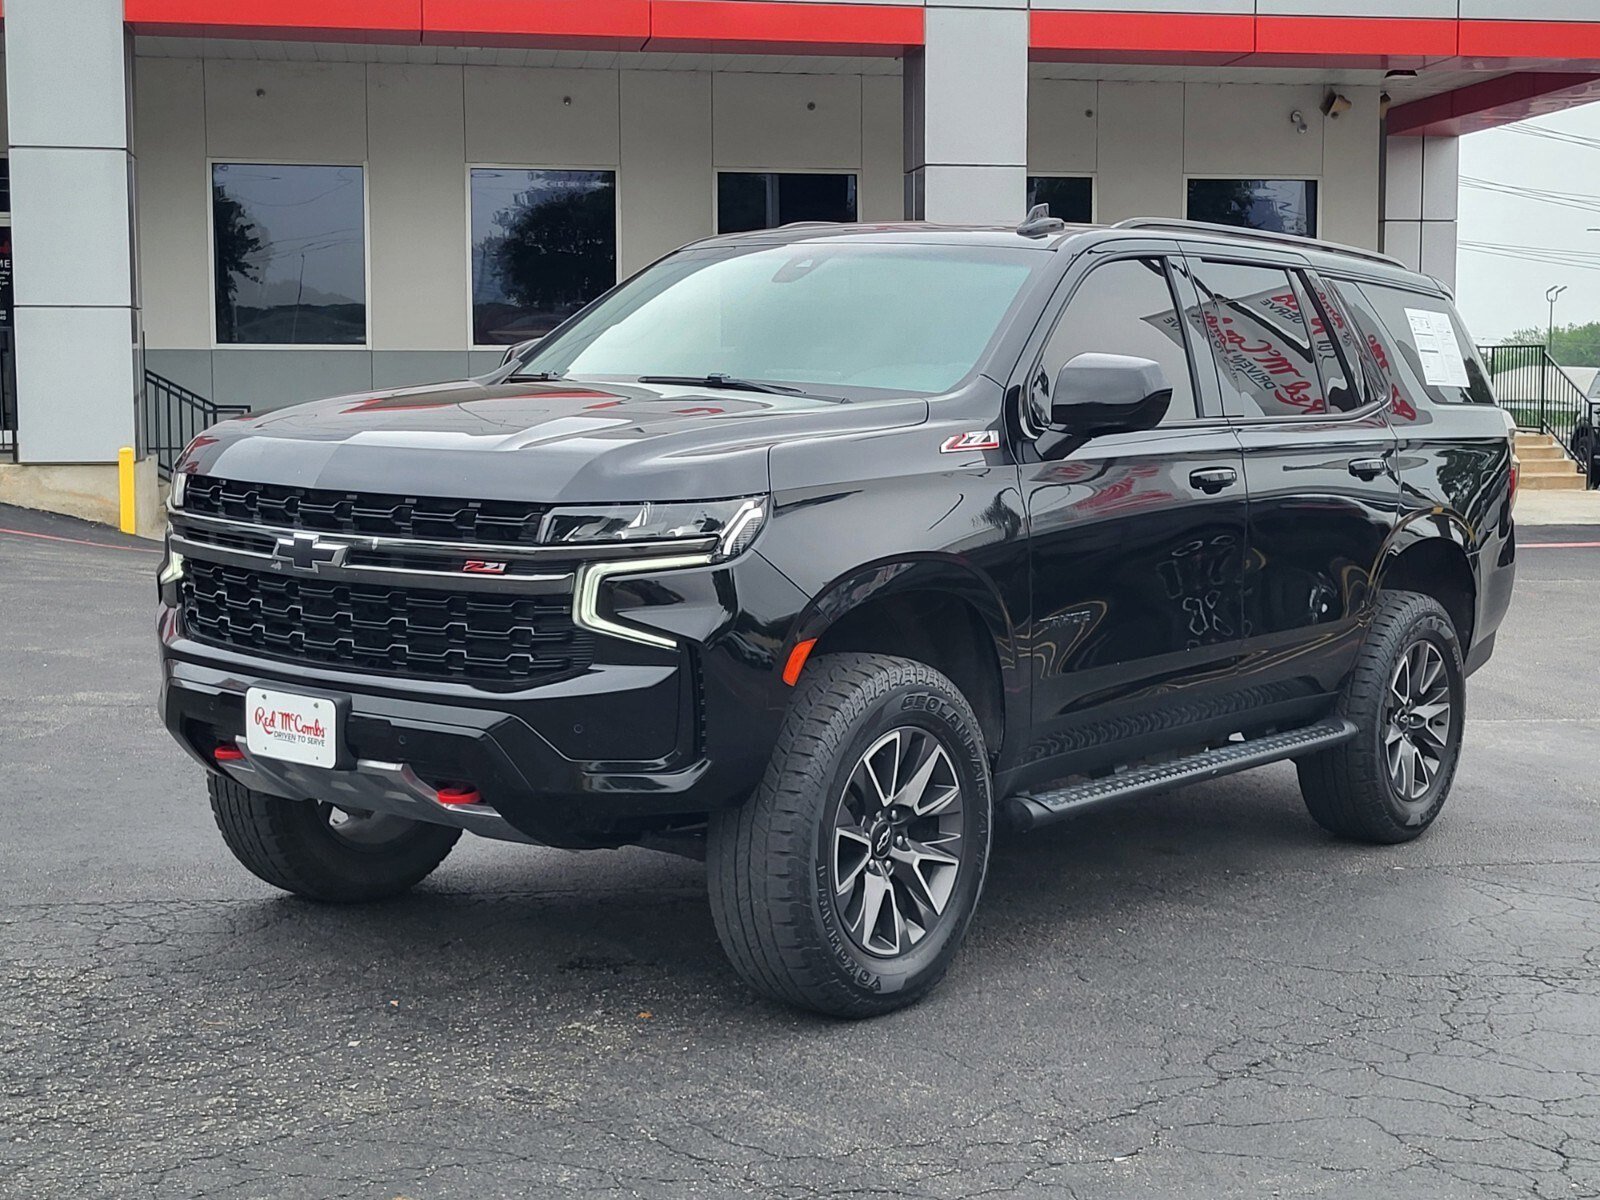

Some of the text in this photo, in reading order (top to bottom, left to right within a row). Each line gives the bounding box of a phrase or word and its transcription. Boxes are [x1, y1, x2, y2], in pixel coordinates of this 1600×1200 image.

[940, 430, 999, 453] Z71
[463, 560, 507, 574] Z71
[255, 707, 325, 738] Red McCombs
[273, 731, 326, 747] DRIVEN TO SERVE
